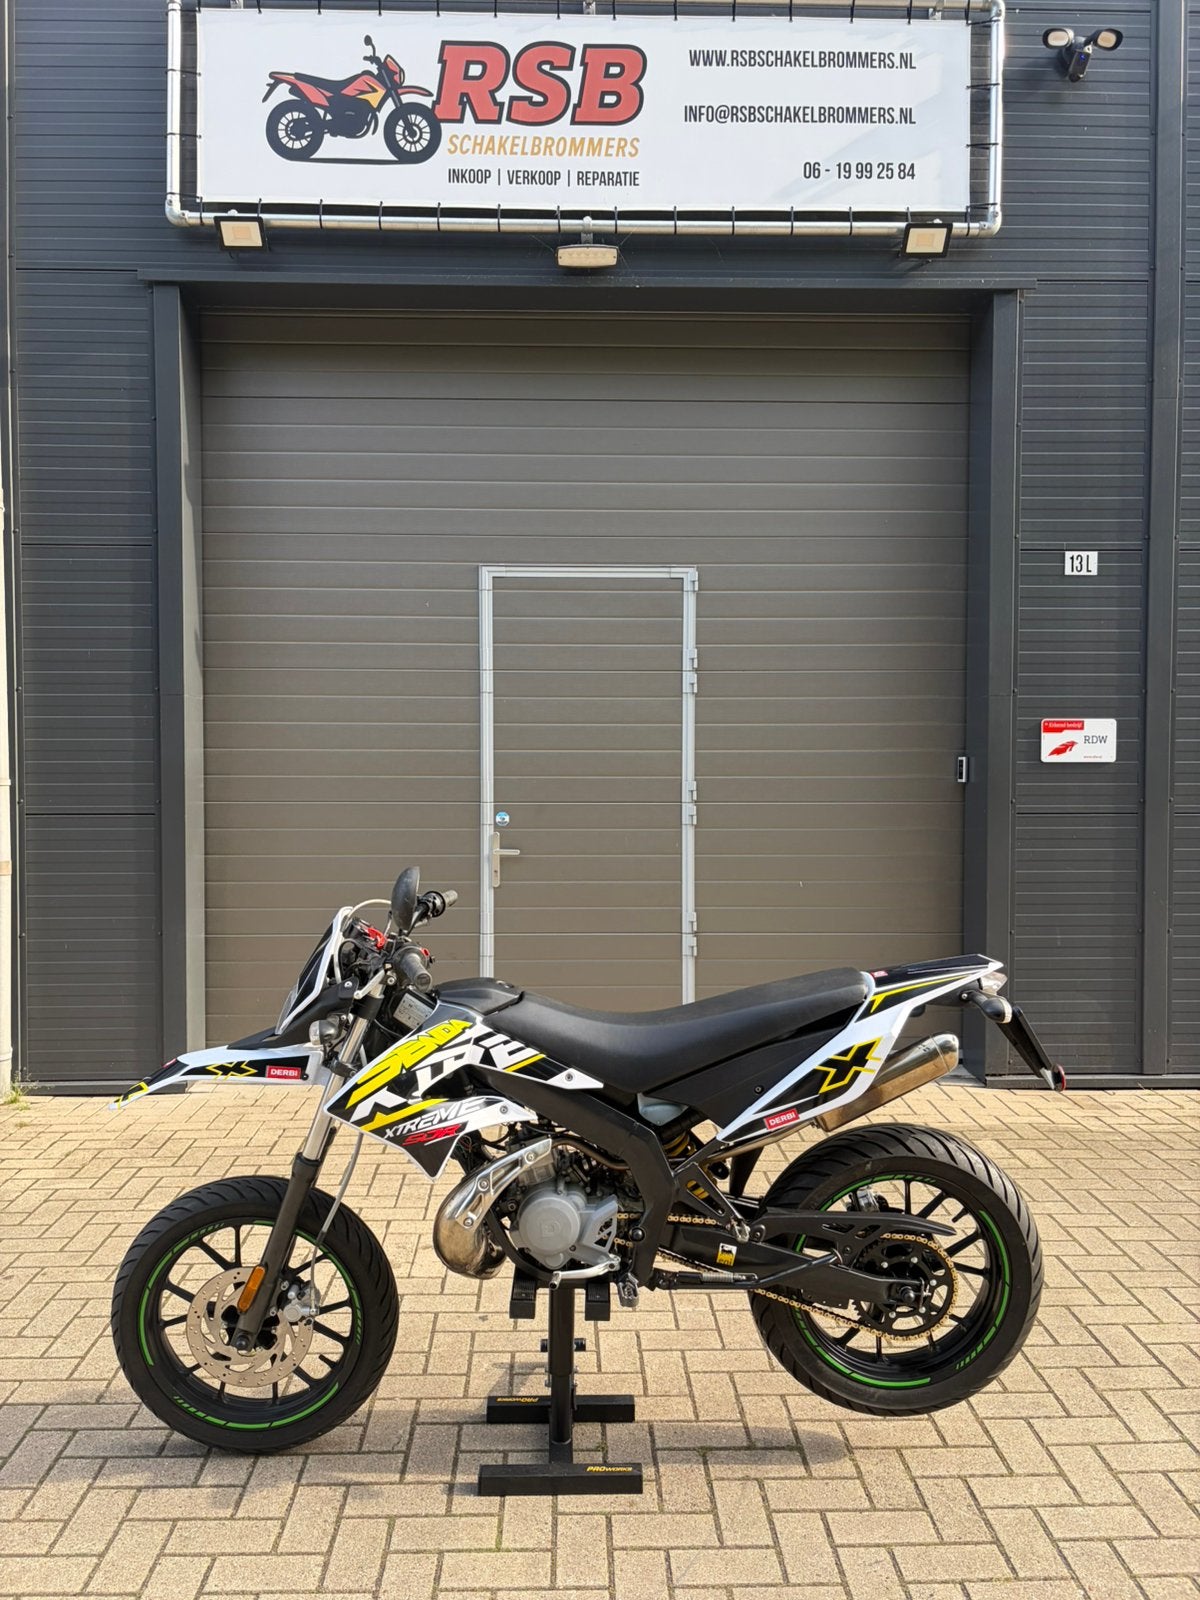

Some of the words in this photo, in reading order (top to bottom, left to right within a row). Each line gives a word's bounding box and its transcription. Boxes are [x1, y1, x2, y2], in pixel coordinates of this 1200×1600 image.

[688, 49, 917, 70] WWW.RSBSCHAKELBROMMERS.NL
[431, 39, 648, 127] RSB
[683, 104, 917, 125] INFO@RSBSCHAKELBROMMERS.NL
[447, 133, 641, 159] SCHAKELBROMMERS
[448, 168, 492, 185] INKOOP
[506, 169, 562, 186] VERKOOP
[576, 170, 640, 187] REPARATIE
[803, 161, 821, 180] 06
[836, 161, 852, 180] 19
[855, 161, 873, 180] 99
[876, 162, 894, 180] 25
[897, 162, 916, 180] 84
[1083, 734, 1108, 745] RDW
[269, 1067, 299, 1078] DERBI
[345, 1019, 474, 1110] SENDA
[384, 1097, 487, 1139] XTREME
[768, 1110, 797, 1127] DERBI
